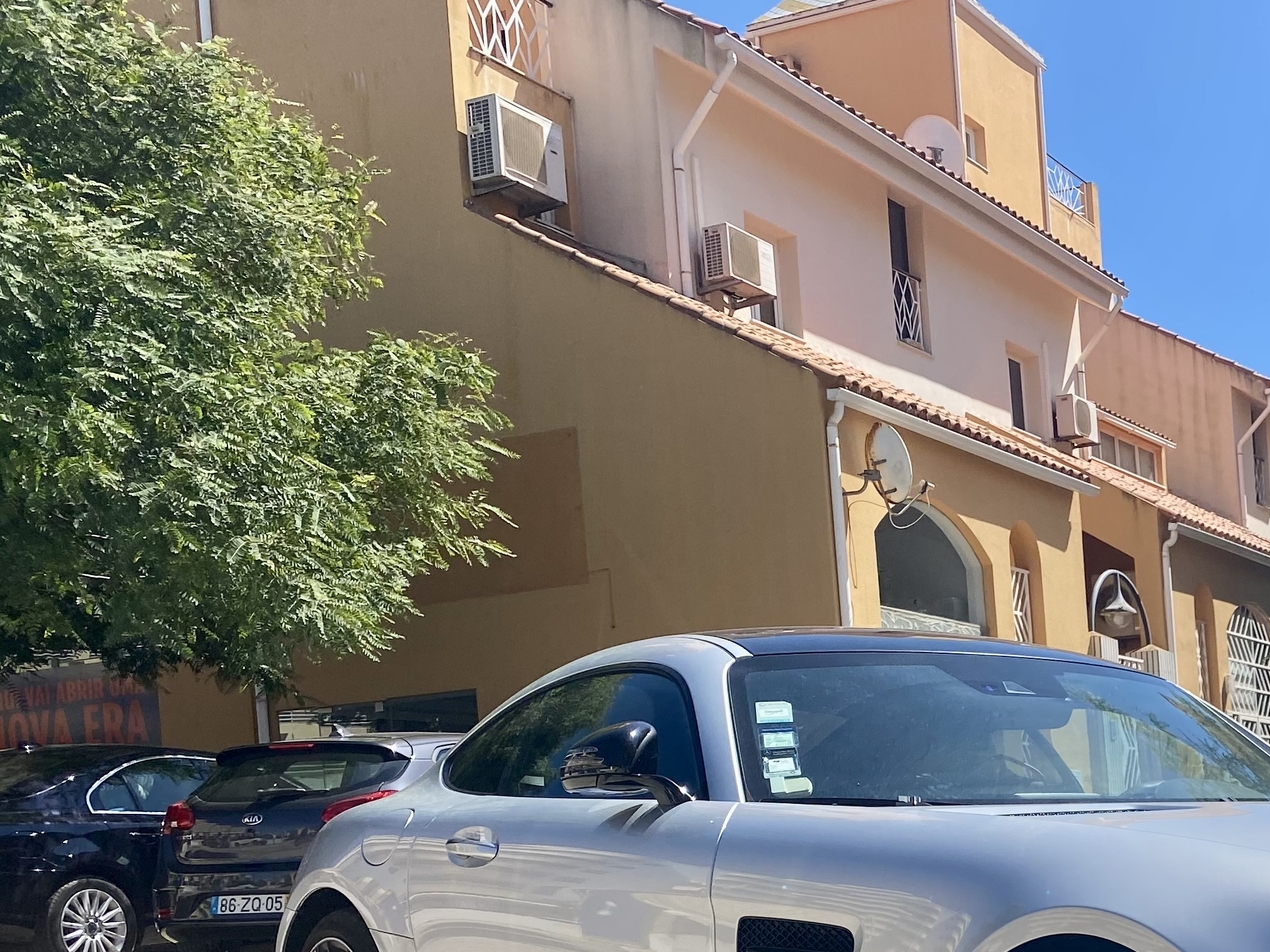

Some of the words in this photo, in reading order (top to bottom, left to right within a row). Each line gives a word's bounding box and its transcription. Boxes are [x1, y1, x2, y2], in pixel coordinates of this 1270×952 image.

[24, 682, 50, 708] VAI
[57, 677, 104, 704] ABRIR
[83, 699, 150, 744] ERA
[244, 815, 259, 823] KIA
